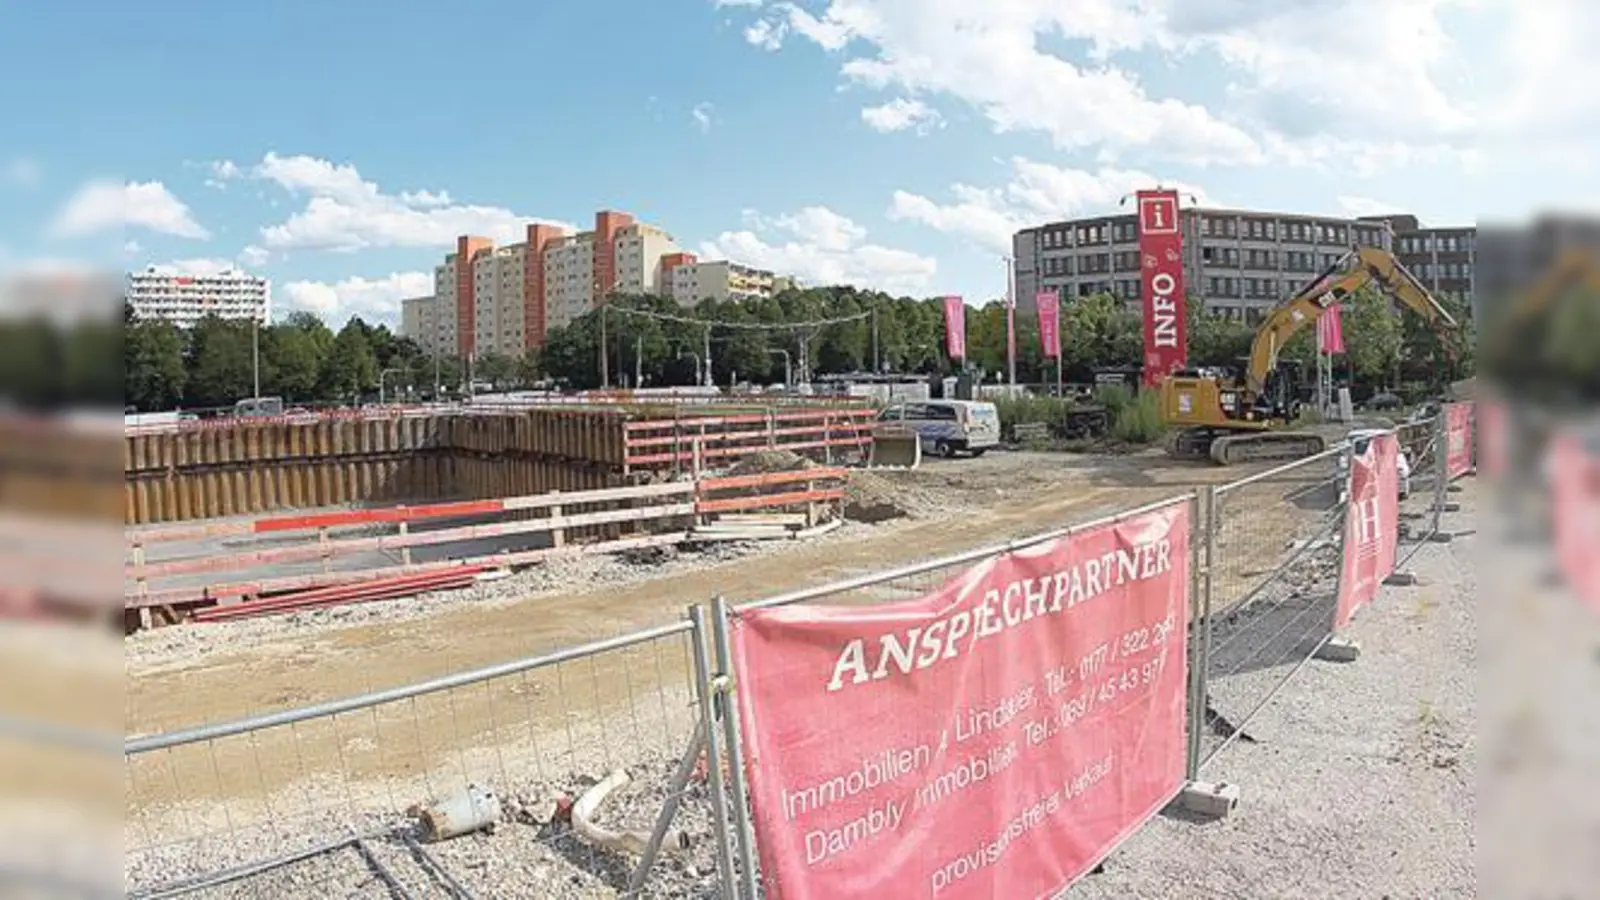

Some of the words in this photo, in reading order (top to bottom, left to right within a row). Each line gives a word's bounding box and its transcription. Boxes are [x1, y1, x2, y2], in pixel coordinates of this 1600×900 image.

[1151, 272, 1177, 348] INFO
[781, 743, 930, 822] Immobilien
[804, 799, 906, 864] Dambly
